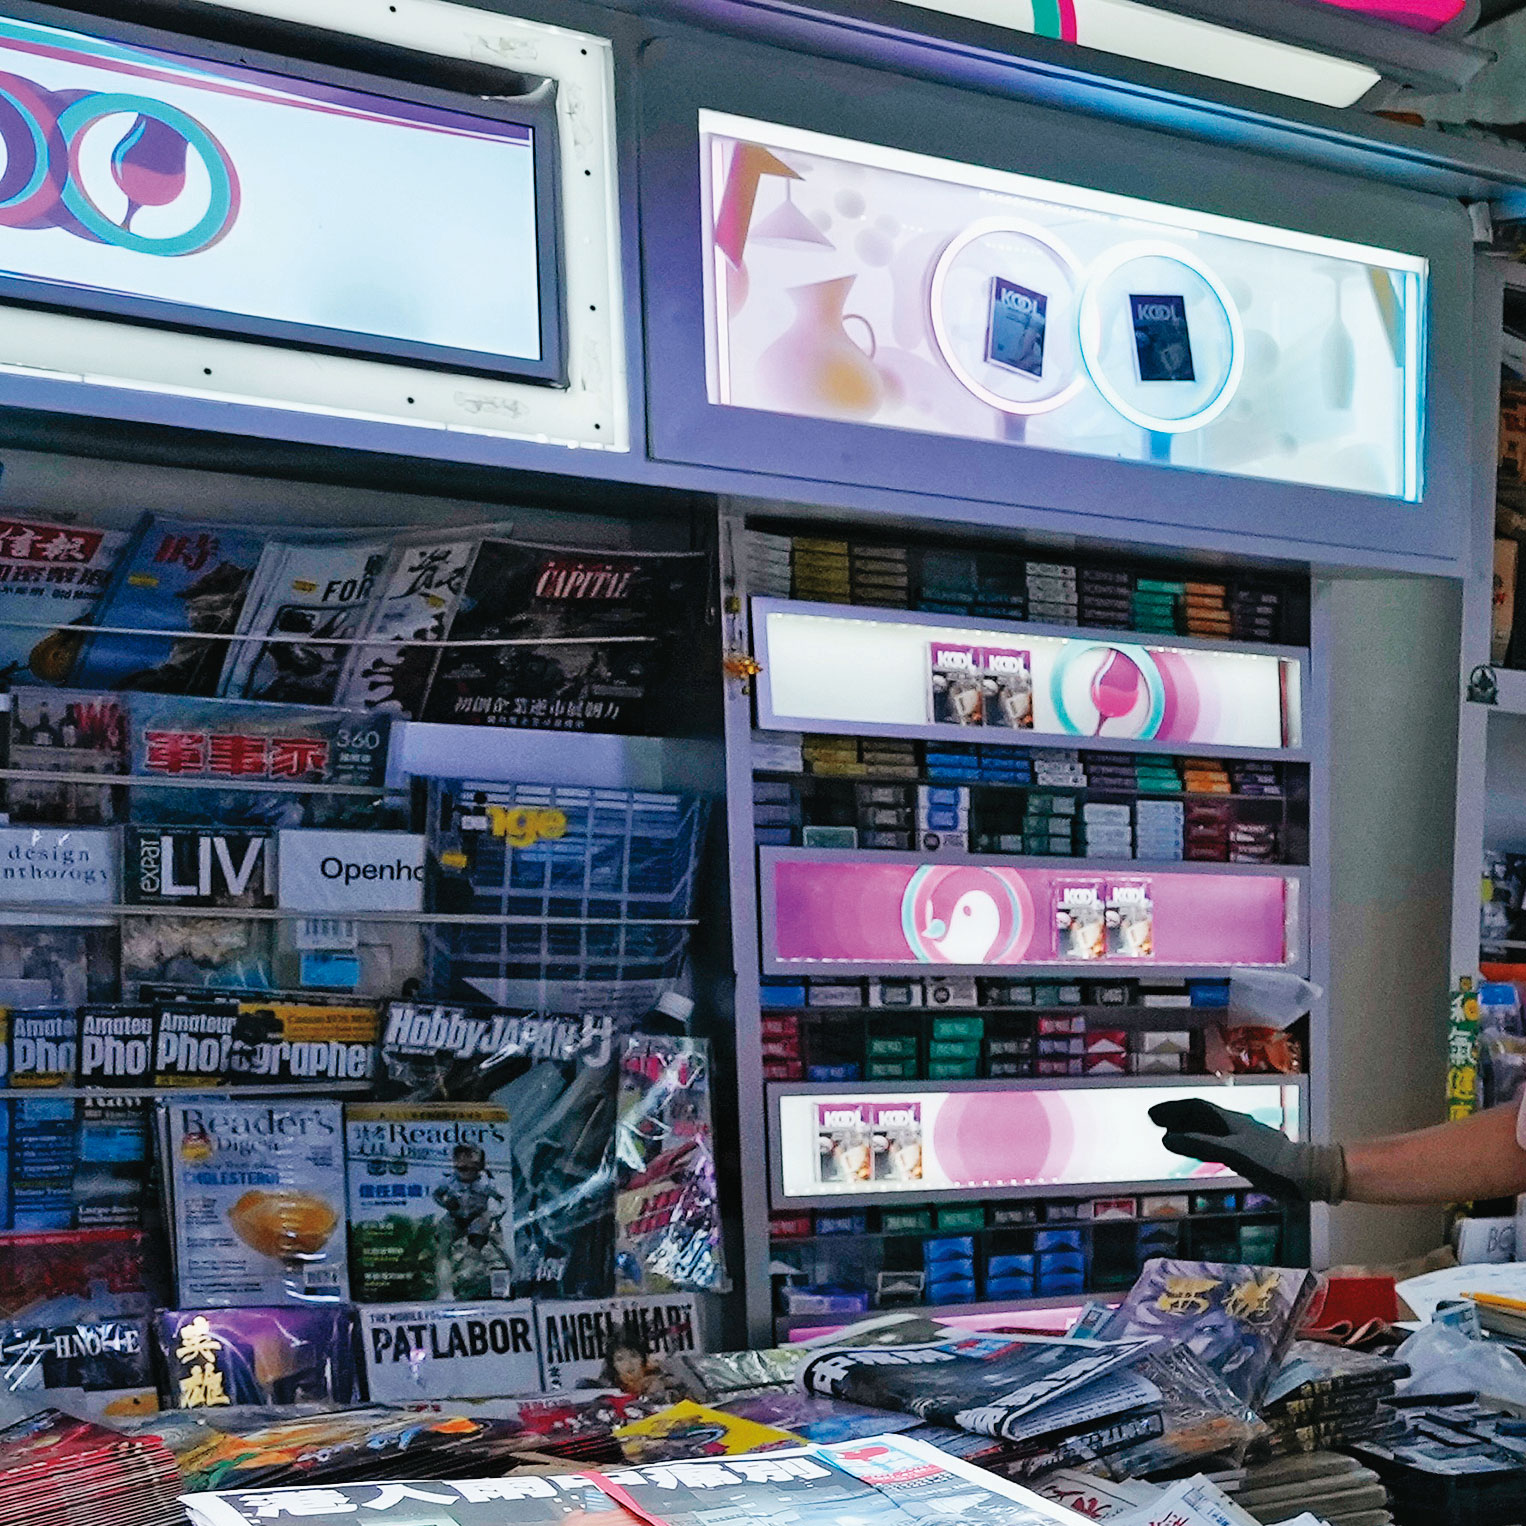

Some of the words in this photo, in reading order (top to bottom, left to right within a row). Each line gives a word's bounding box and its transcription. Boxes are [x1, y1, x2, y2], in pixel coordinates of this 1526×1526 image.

[1000, 286, 1047, 312] KOOL
[936, 649, 977, 669] KOOL
[336, 730, 381, 750] 360
[390, 1122, 506, 1145] Reader's
[372, 1316, 534, 1364] PATLABOR
